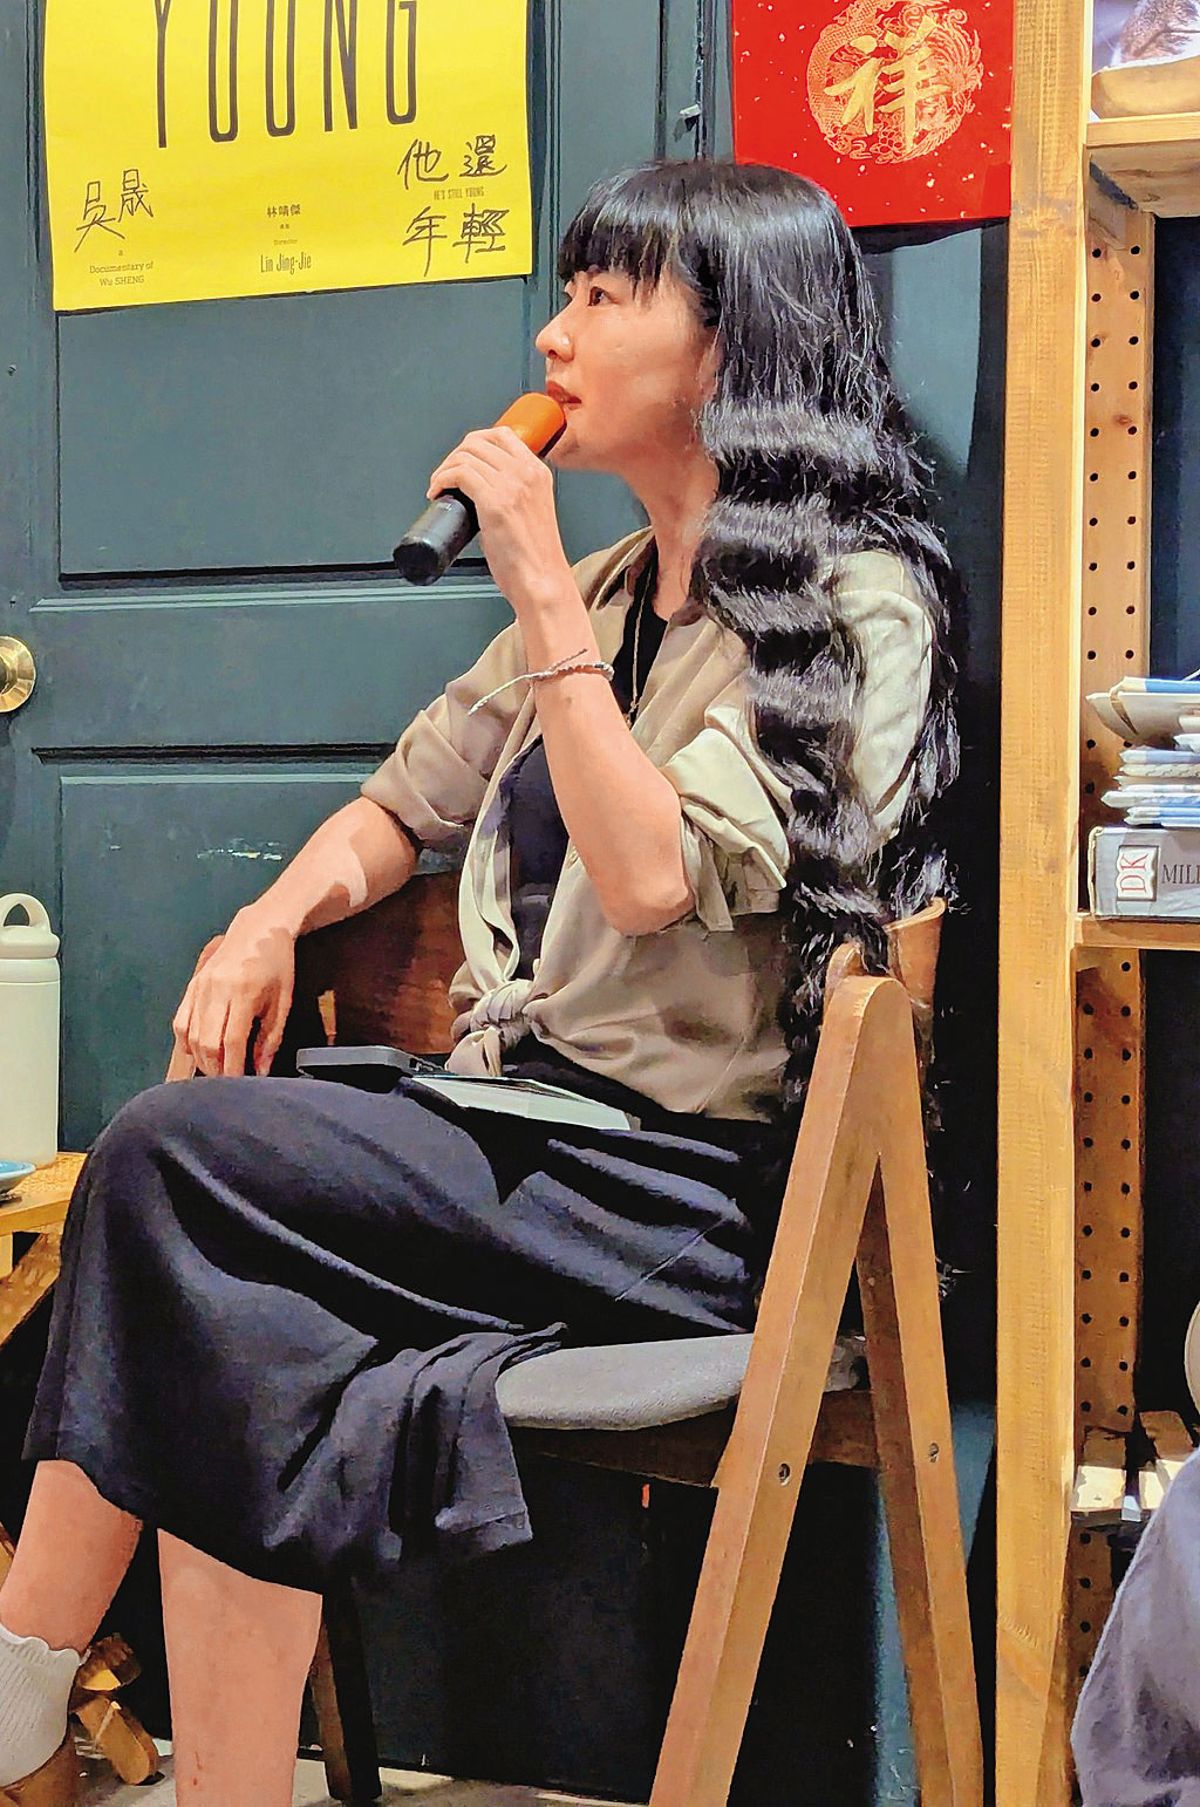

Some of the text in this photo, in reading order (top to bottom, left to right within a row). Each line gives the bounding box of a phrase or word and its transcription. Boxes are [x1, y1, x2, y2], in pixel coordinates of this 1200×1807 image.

[402, 202, 510, 277] 年輕
[89, 261, 154, 274] Documentary of
[260, 251, 312, 275] Lin Jing-Jie
[115, 275, 145, 286] SHENG
[1120, 853, 1148, 892] DK
